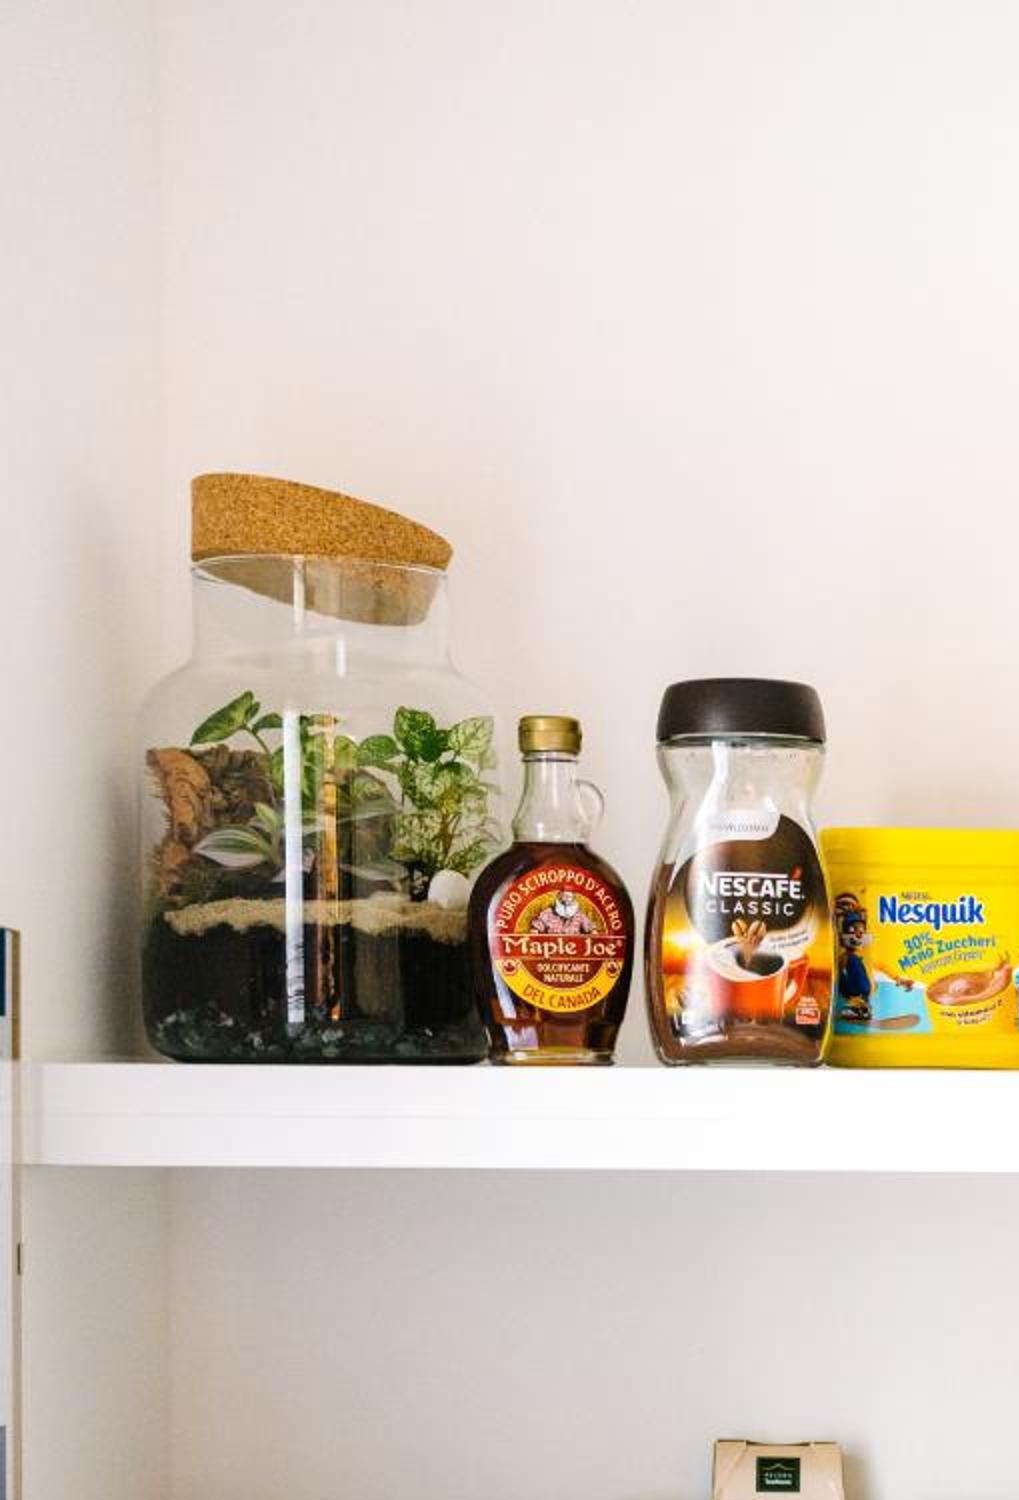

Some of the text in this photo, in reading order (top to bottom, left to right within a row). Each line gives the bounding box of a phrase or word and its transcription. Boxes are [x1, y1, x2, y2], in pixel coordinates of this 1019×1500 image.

[496, 868, 623, 931] PURO SCIROPPO D'ACERO
[705, 900, 795, 916] CLASSIC
[878, 895, 985, 931] Nesquik
[502, 936, 617, 959] Maple Joe
[897, 948, 935, 972] Meno
[935, 934, 996, 952] Zuccheri
[903, 931, 935, 954] 30%
[523, 984, 602, 1010] DEL CANADA
